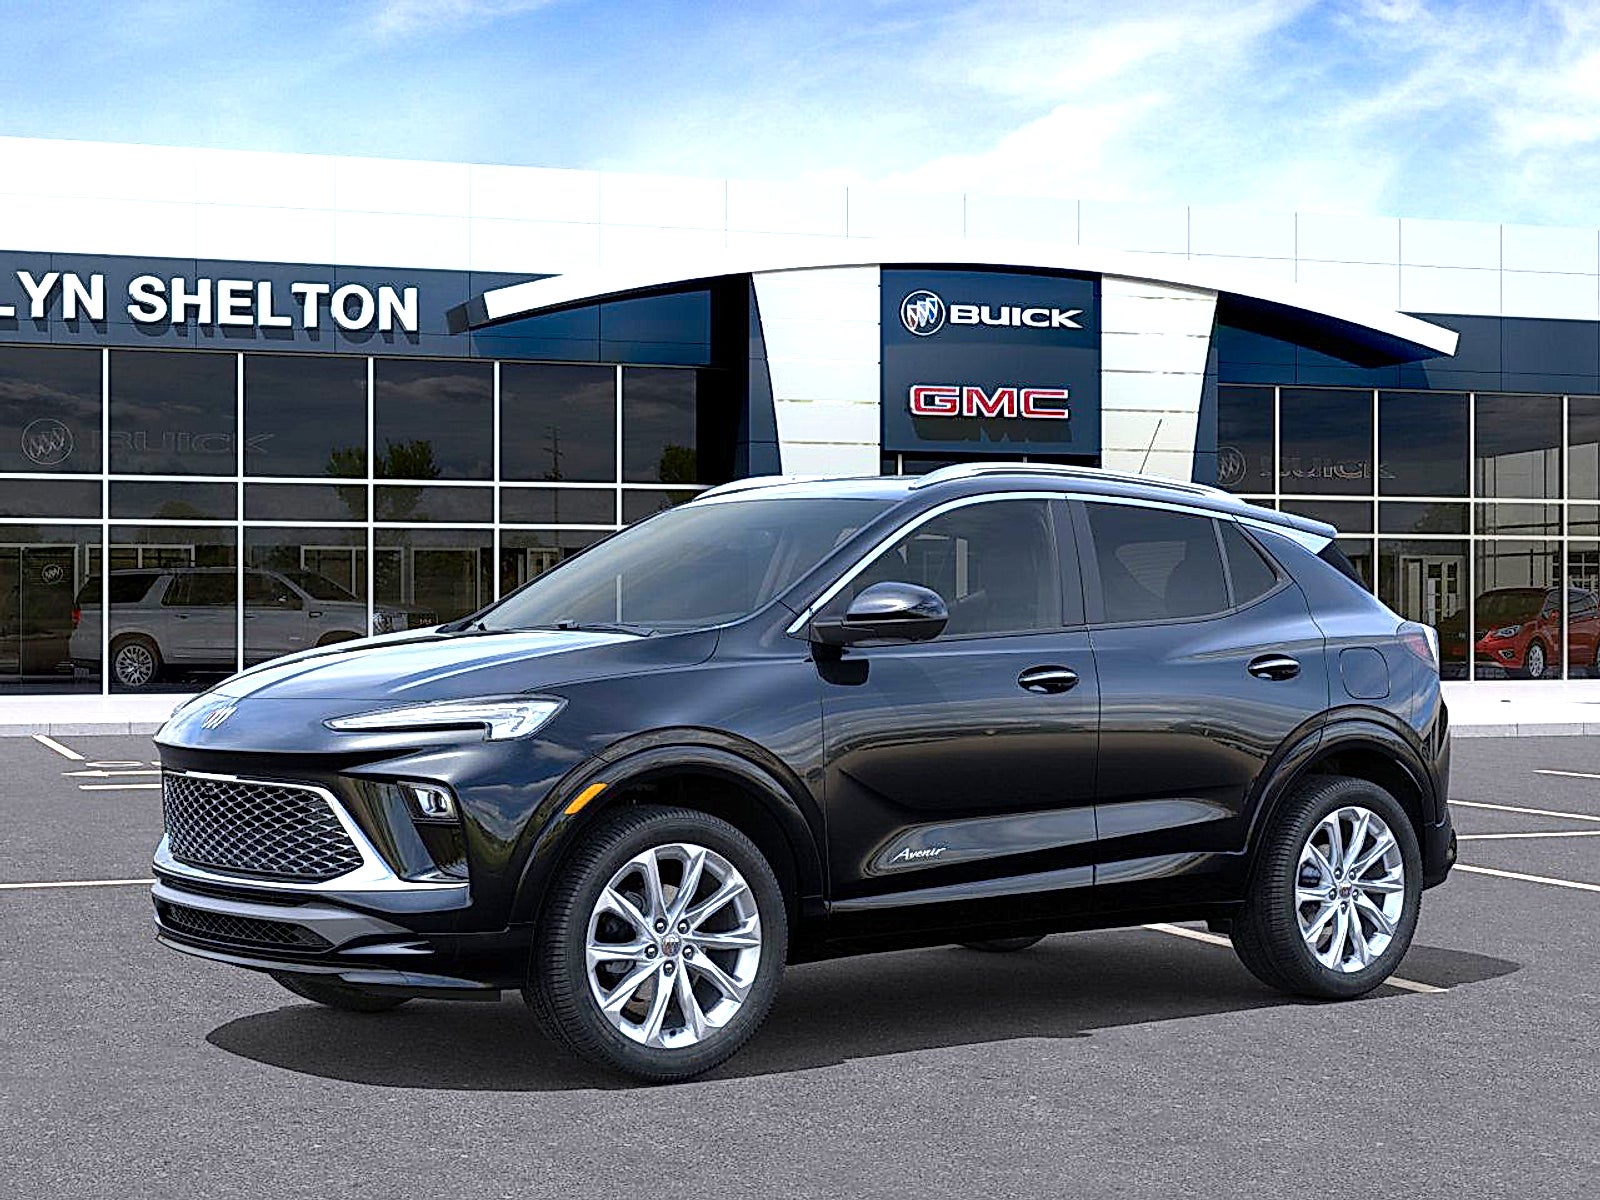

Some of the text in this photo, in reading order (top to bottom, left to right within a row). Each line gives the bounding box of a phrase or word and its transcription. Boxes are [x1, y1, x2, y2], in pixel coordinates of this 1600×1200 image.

[127, 275, 418, 331] SHELTON
[949, 304, 1084, 329] BUICK
[909, 385, 1069, 419] GMC
[888, 847, 947, 864] Avenir
